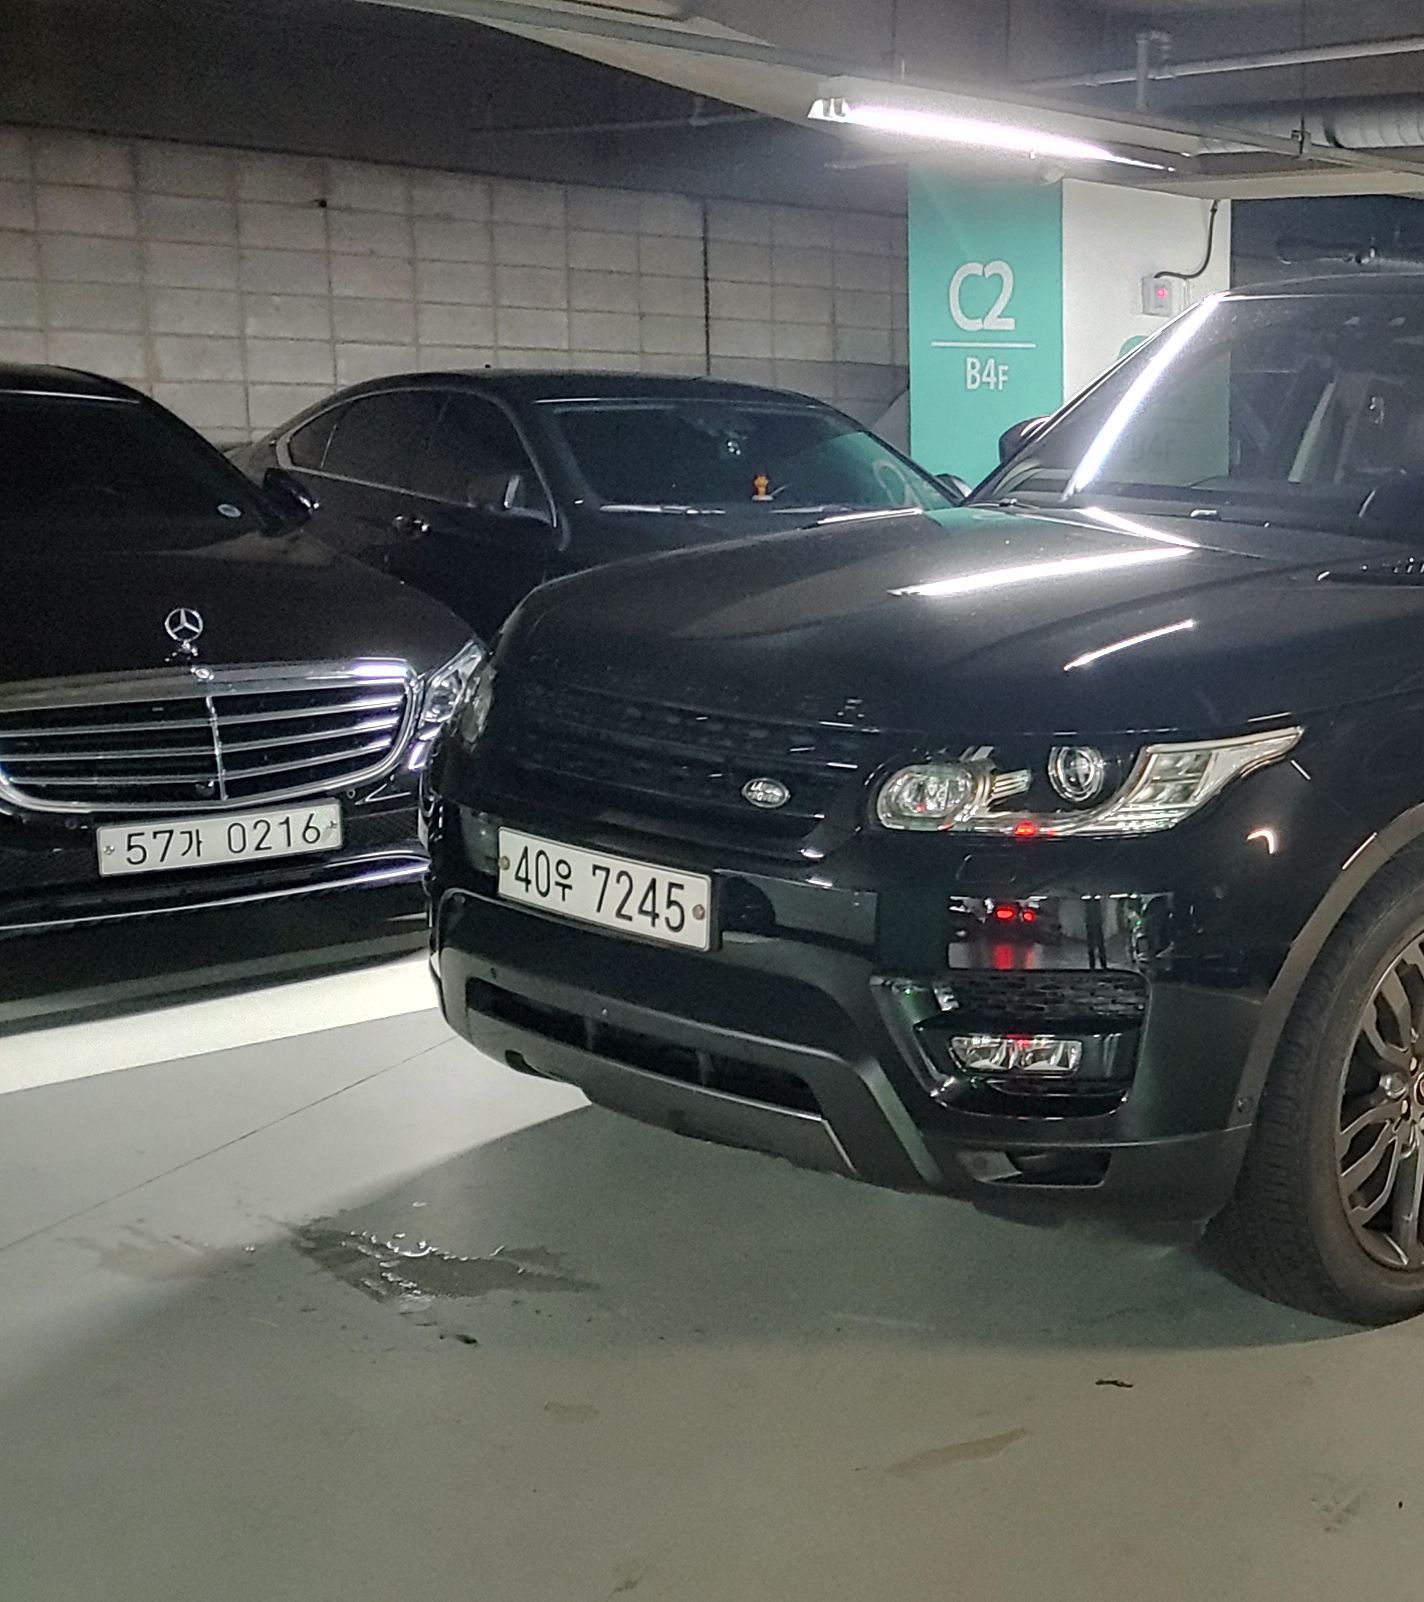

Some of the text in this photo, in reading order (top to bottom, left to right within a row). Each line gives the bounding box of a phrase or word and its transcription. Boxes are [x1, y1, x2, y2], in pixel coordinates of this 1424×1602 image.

[948, 260, 1016, 332] C2
[965, 356, 1010, 391] B4F
[125, 812, 322, 866] 57가 0216
[514, 844, 687, 933] 40우 7245
